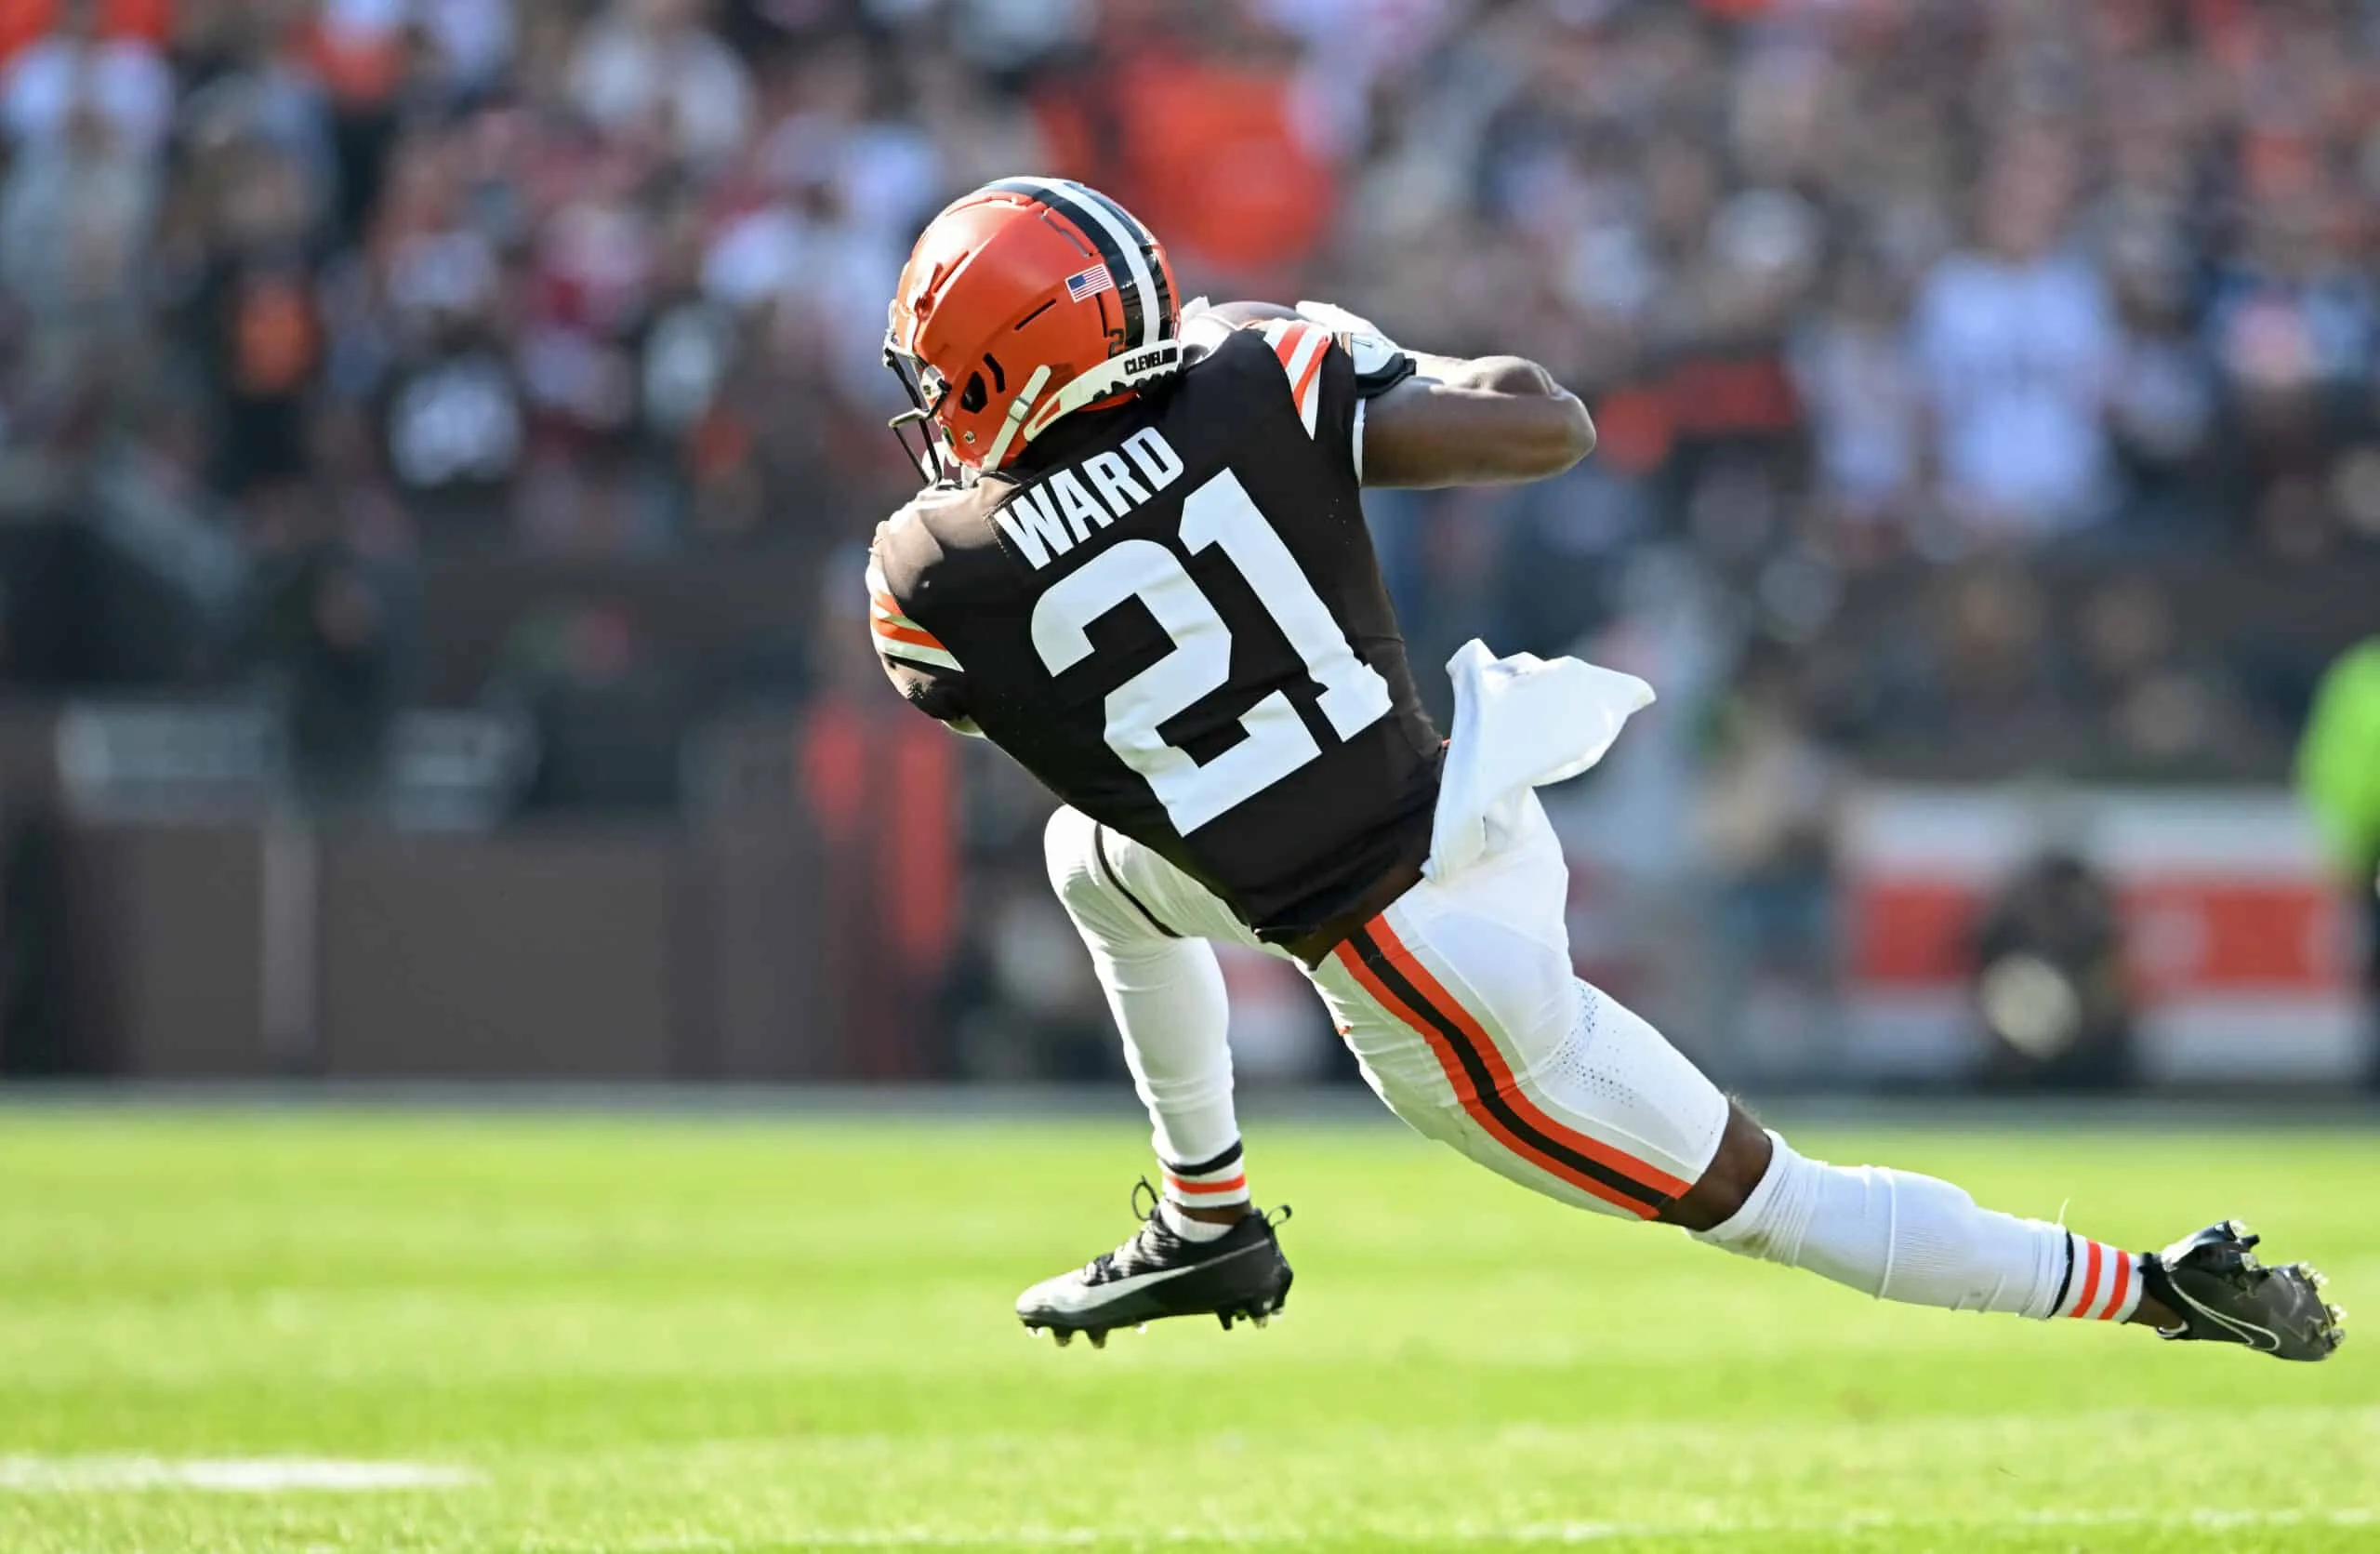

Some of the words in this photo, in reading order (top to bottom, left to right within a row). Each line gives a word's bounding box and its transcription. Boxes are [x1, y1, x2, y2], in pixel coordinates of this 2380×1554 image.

[1124, 347, 1178, 375] CLEVEL
[994, 426, 1184, 570] WARD
[1031, 467, 1393, 837] 21
